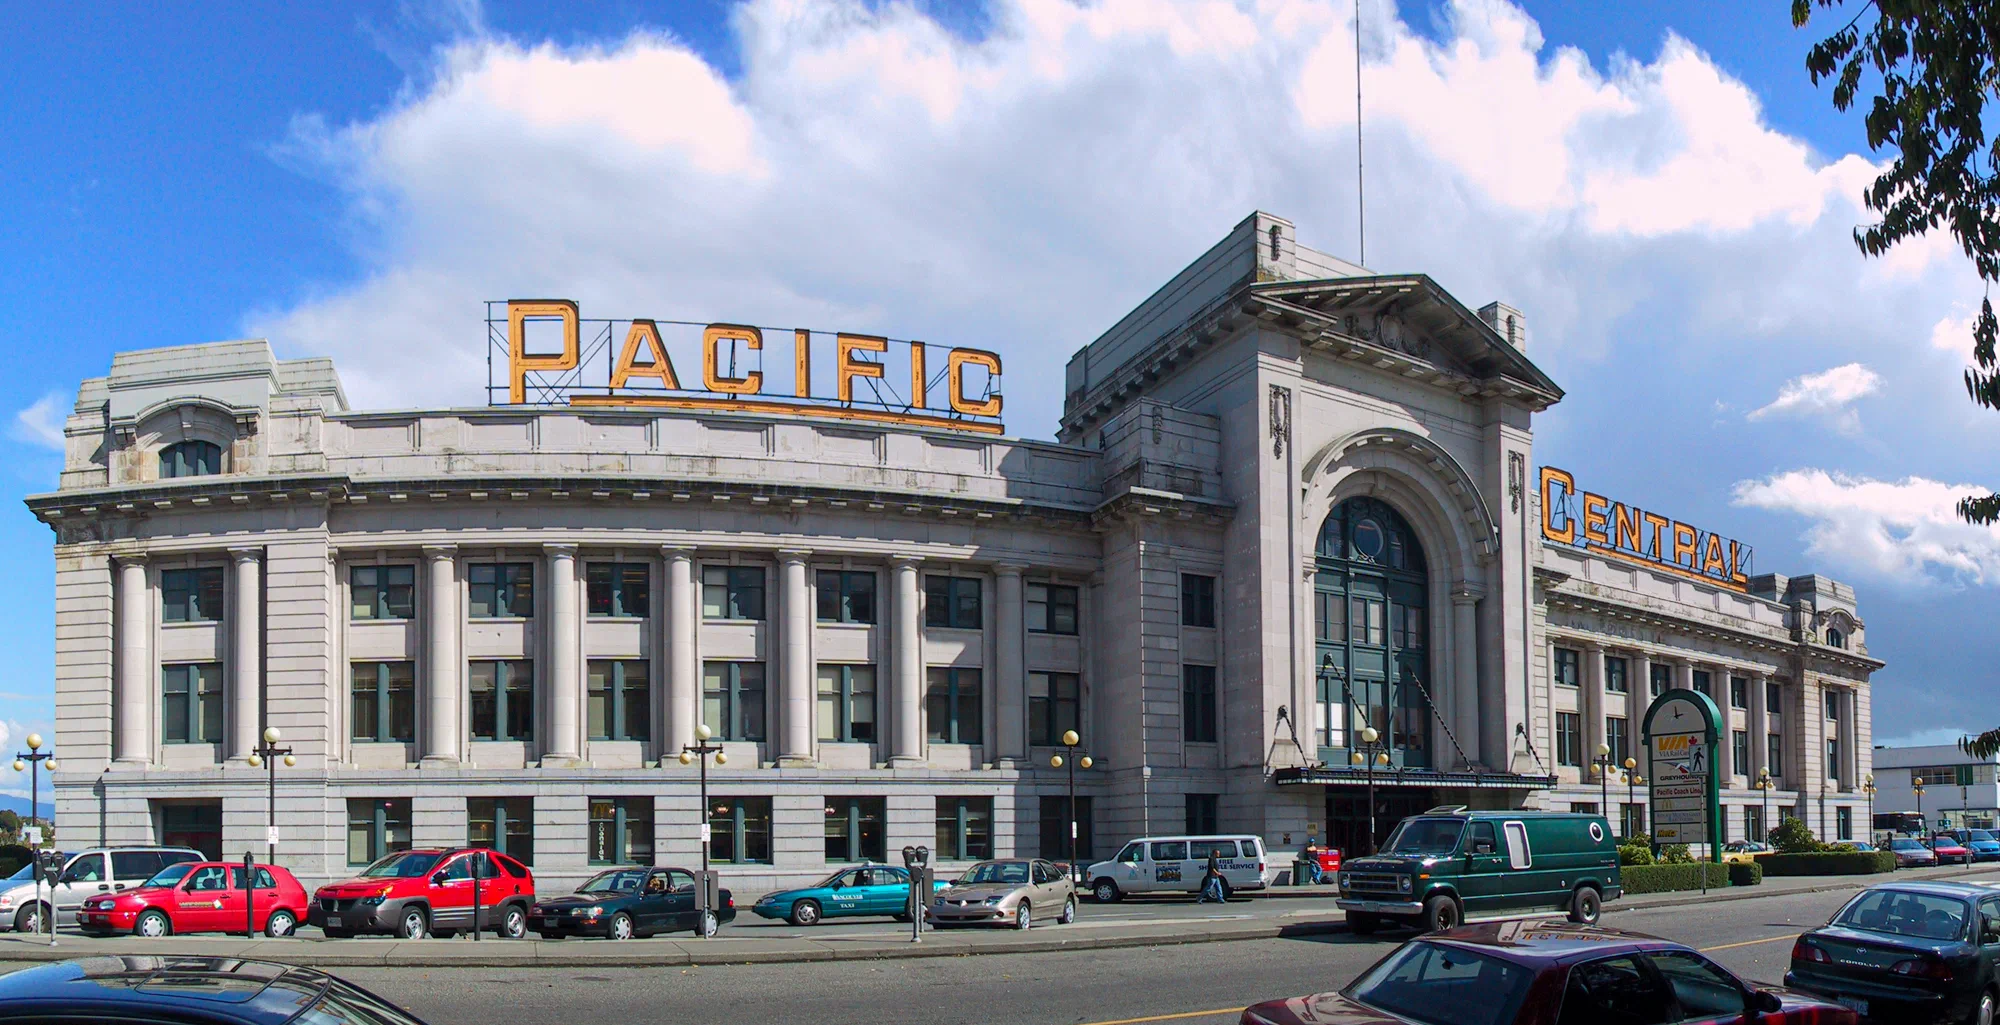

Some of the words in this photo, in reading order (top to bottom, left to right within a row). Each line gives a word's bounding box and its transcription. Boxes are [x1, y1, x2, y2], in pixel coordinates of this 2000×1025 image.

[508, 299, 1003, 417] PACIFIC
[1541, 466, 1747, 584] CENTRAL
[1658, 736, 1688, 751] VIA
[1840, 959, 1880, 969] COROLLA
